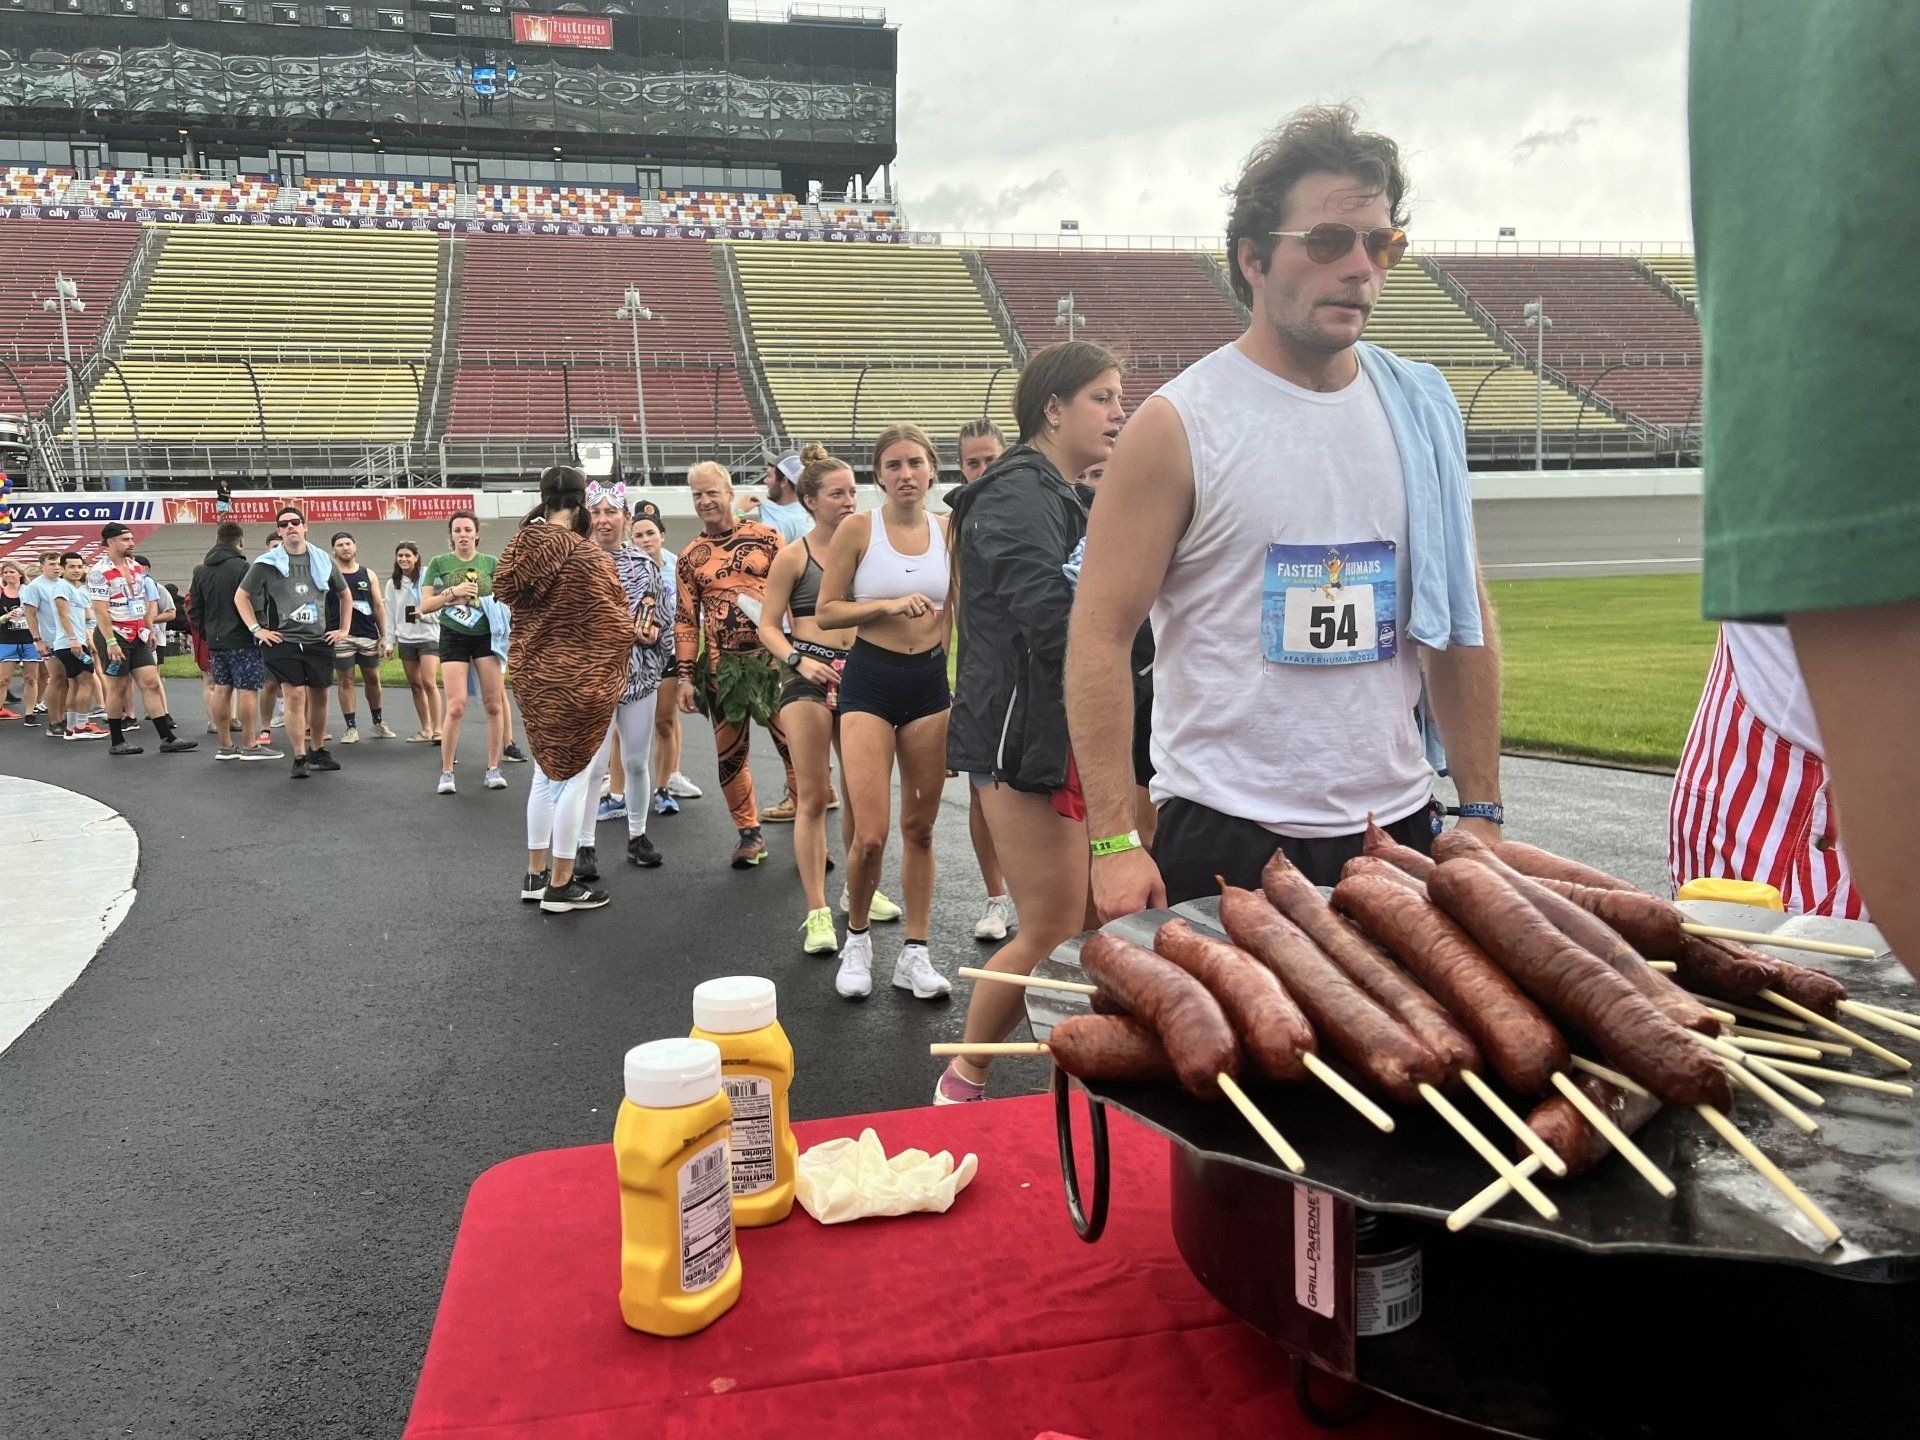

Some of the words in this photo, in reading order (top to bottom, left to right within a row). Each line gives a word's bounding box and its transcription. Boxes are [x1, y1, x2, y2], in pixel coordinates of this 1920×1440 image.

[126, 1, 133, 10] 5
[181, 4, 188, 12] 6
[234, 7, 242, 16] 7
[288, 10, 296, 19] 8
[342, 13, 350, 22] 9
[391, 16, 404, 25] 10
[49, 208, 69, 219] ally
[107, 209, 127, 221] ally
[164, 212, 184, 223] ally
[223, 213, 242, 224] ally
[278, 216, 297, 227] ally
[332, 217, 351, 228] ally
[386, 219, 405, 230] ally
[437, 221, 456, 232] ally
[492, 222, 510, 233] ally
[542, 223, 560, 234] ally
[591, 225, 610, 236] ally
[640, 227, 658, 237] ally
[688, 228, 706, 239] ally
[738, 229, 755, 240] ally
[785, 231, 801, 241] ally
[831, 231, 847, 242] ally
[876, 232, 892, 243] ally
[204, 501, 270, 513] FIKEEPERS
[310, 500, 373, 512] FIREKEEPERS
[412, 498, 473, 511] FIREKEEPERS
[1277, 562, 1322, 578] FASTER
[1345, 560, 1381, 575] HUMANS
[1309, 603, 1358, 649] 54
[808, 644, 835, 658] PRO
[741, 1148, 771, 1158] Calories
[732, 1173, 772, 1182] Nutrition
